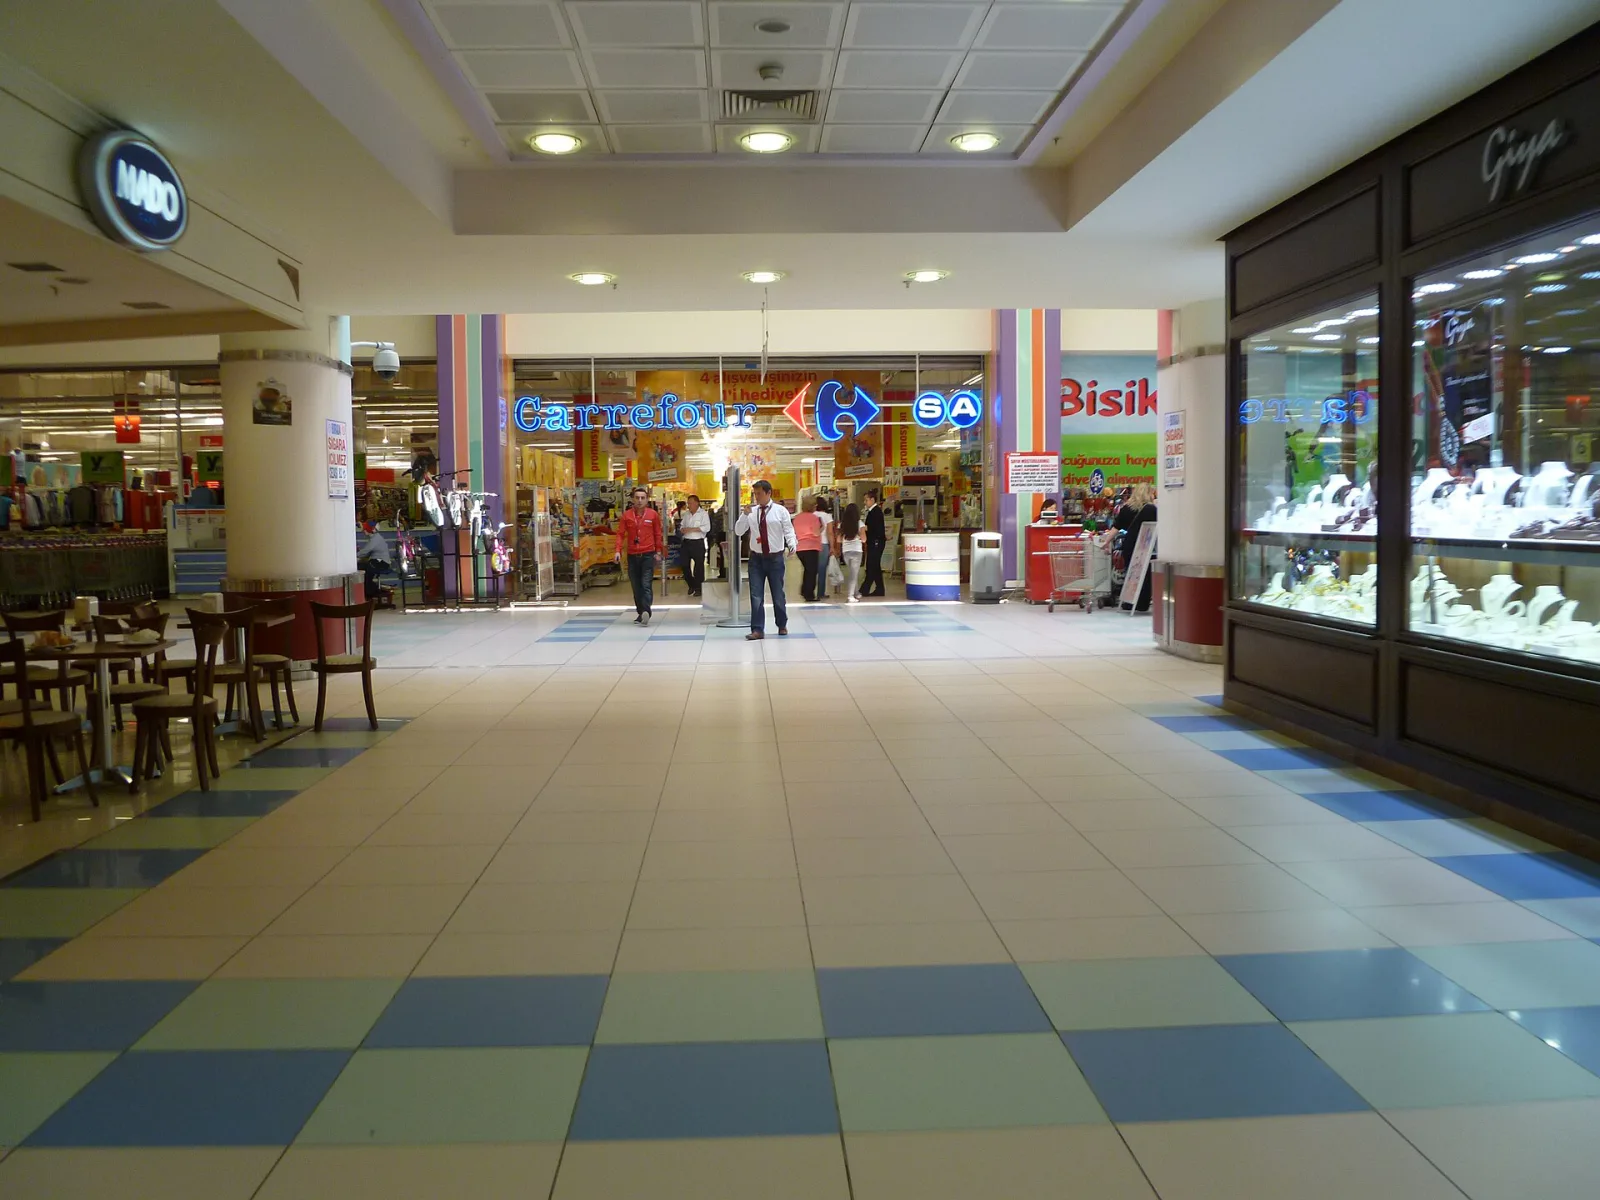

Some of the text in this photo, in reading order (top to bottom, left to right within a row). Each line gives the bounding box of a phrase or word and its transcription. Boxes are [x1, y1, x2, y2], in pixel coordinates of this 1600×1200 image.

[116, 158, 180, 222] MADO
[700, 372, 711, 385] 4
[514, 393, 757, 432] Carrefour
[917, 396, 978, 420] SA
